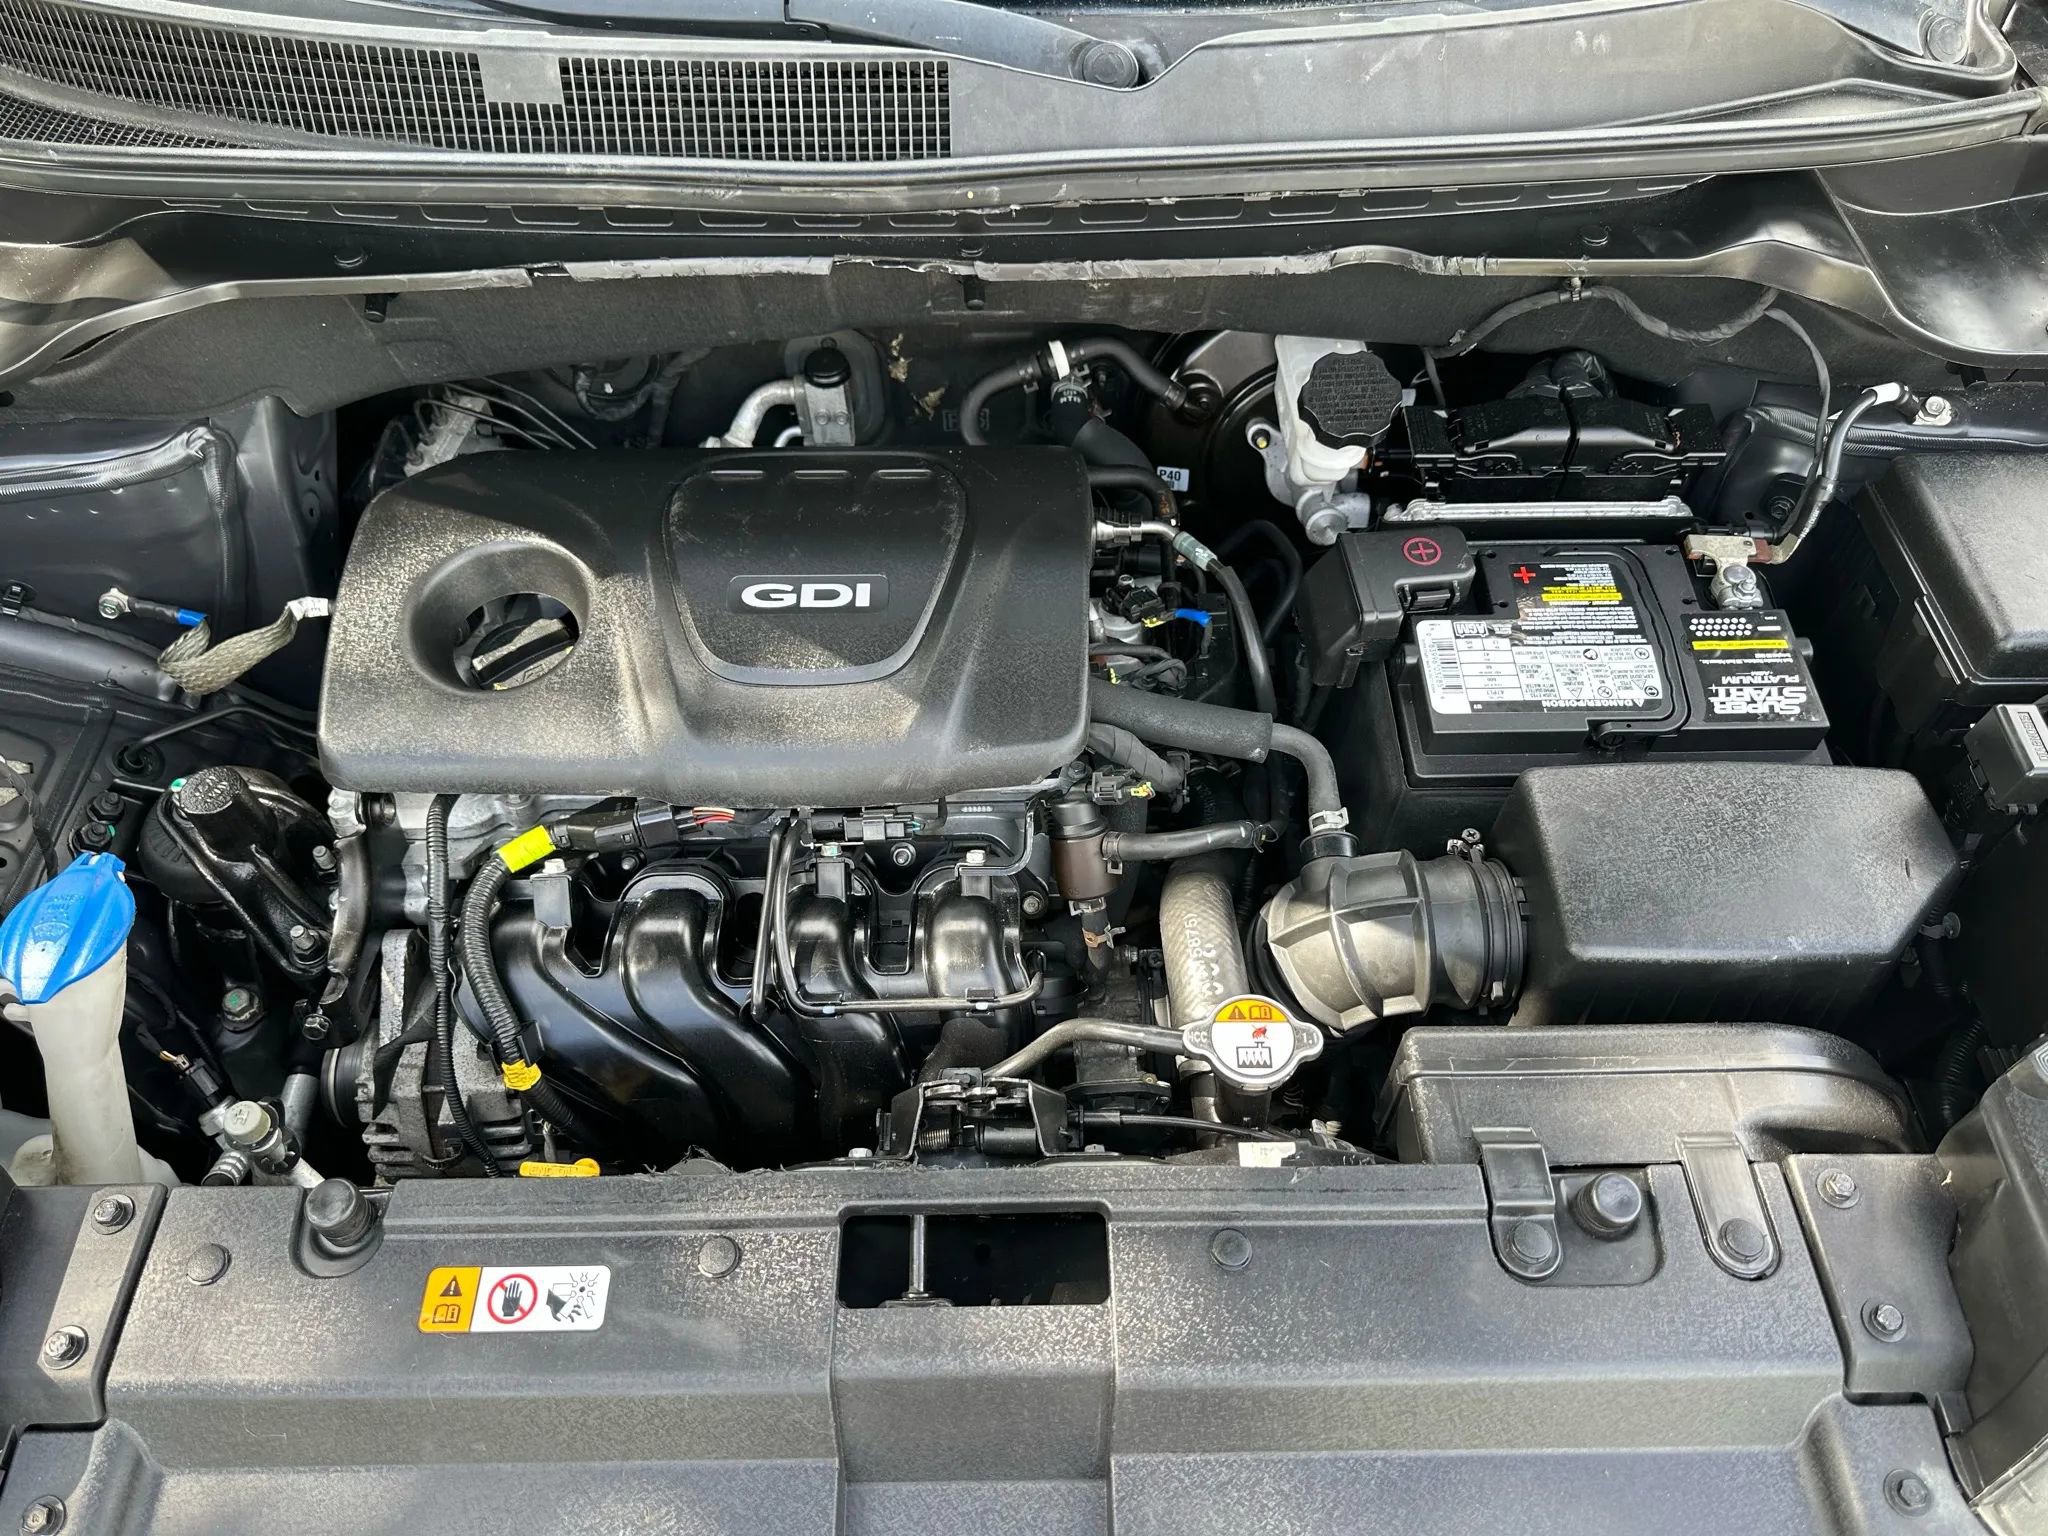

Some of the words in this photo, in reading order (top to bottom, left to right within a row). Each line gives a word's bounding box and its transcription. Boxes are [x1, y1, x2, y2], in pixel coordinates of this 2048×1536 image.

[1160, 470, 1181, 481] P40
[741, 583, 871, 608] GDI
[1456, 623, 1485, 634] AGM
[1722, 675, 1799, 684] PLATINUM
[1708, 686, 1807, 704] START
[1542, 699, 1633, 707] DANGER/POISON
[1713, 700, 1801, 714] SUPER
